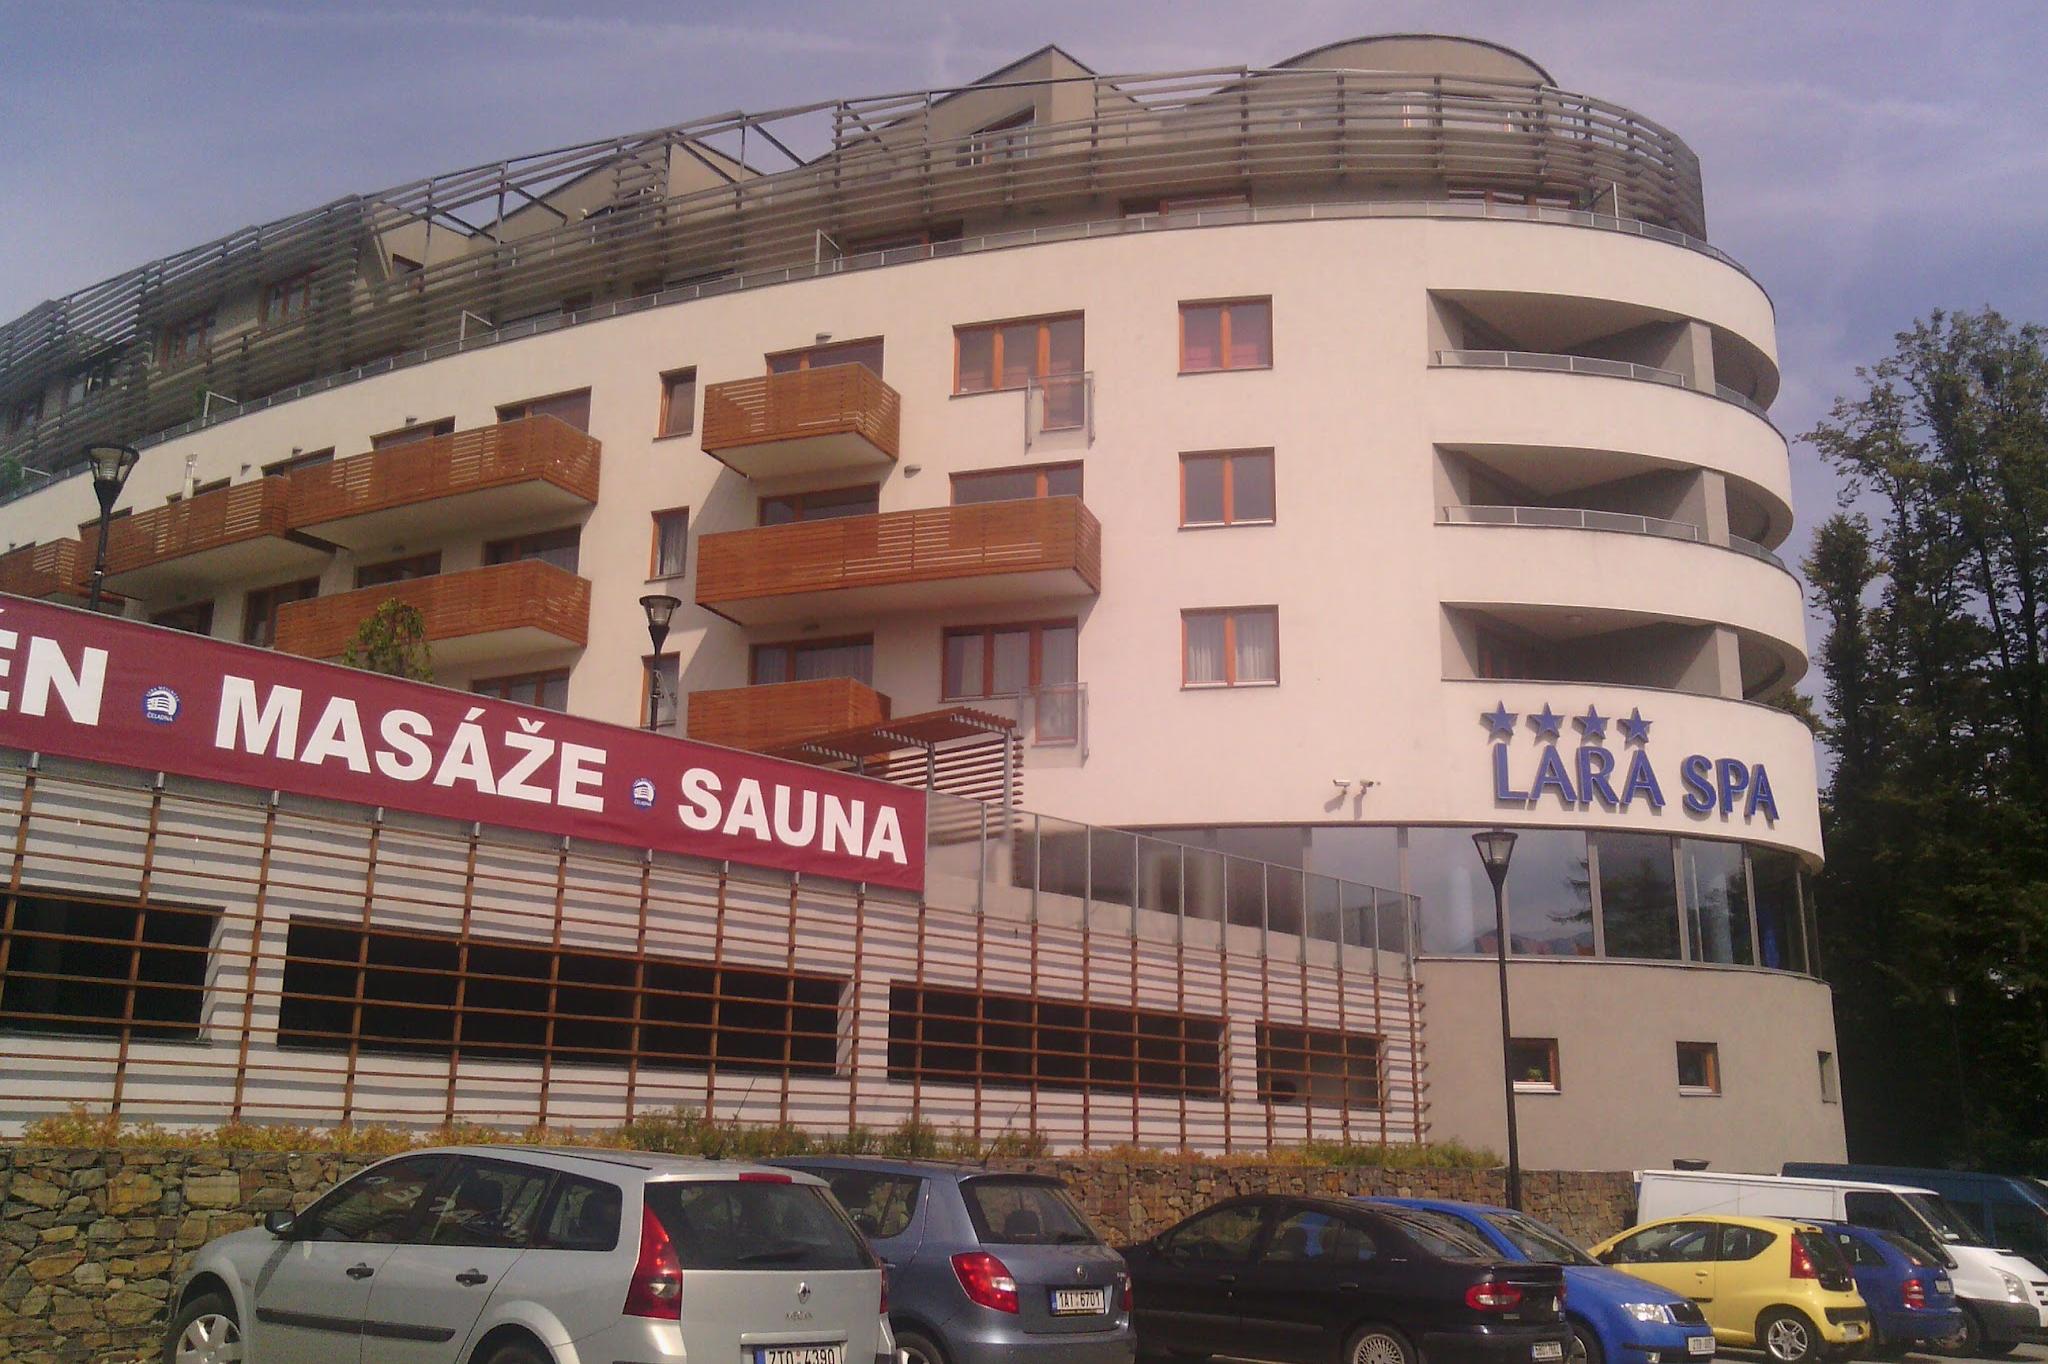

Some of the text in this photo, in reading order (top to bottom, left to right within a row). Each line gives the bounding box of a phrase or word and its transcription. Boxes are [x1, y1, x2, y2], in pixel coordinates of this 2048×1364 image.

[216, 675, 607, 813] MASÁŽE
[678, 768, 908, 865] SAUNA
[1493, 743, 1780, 821] LARA SPA
